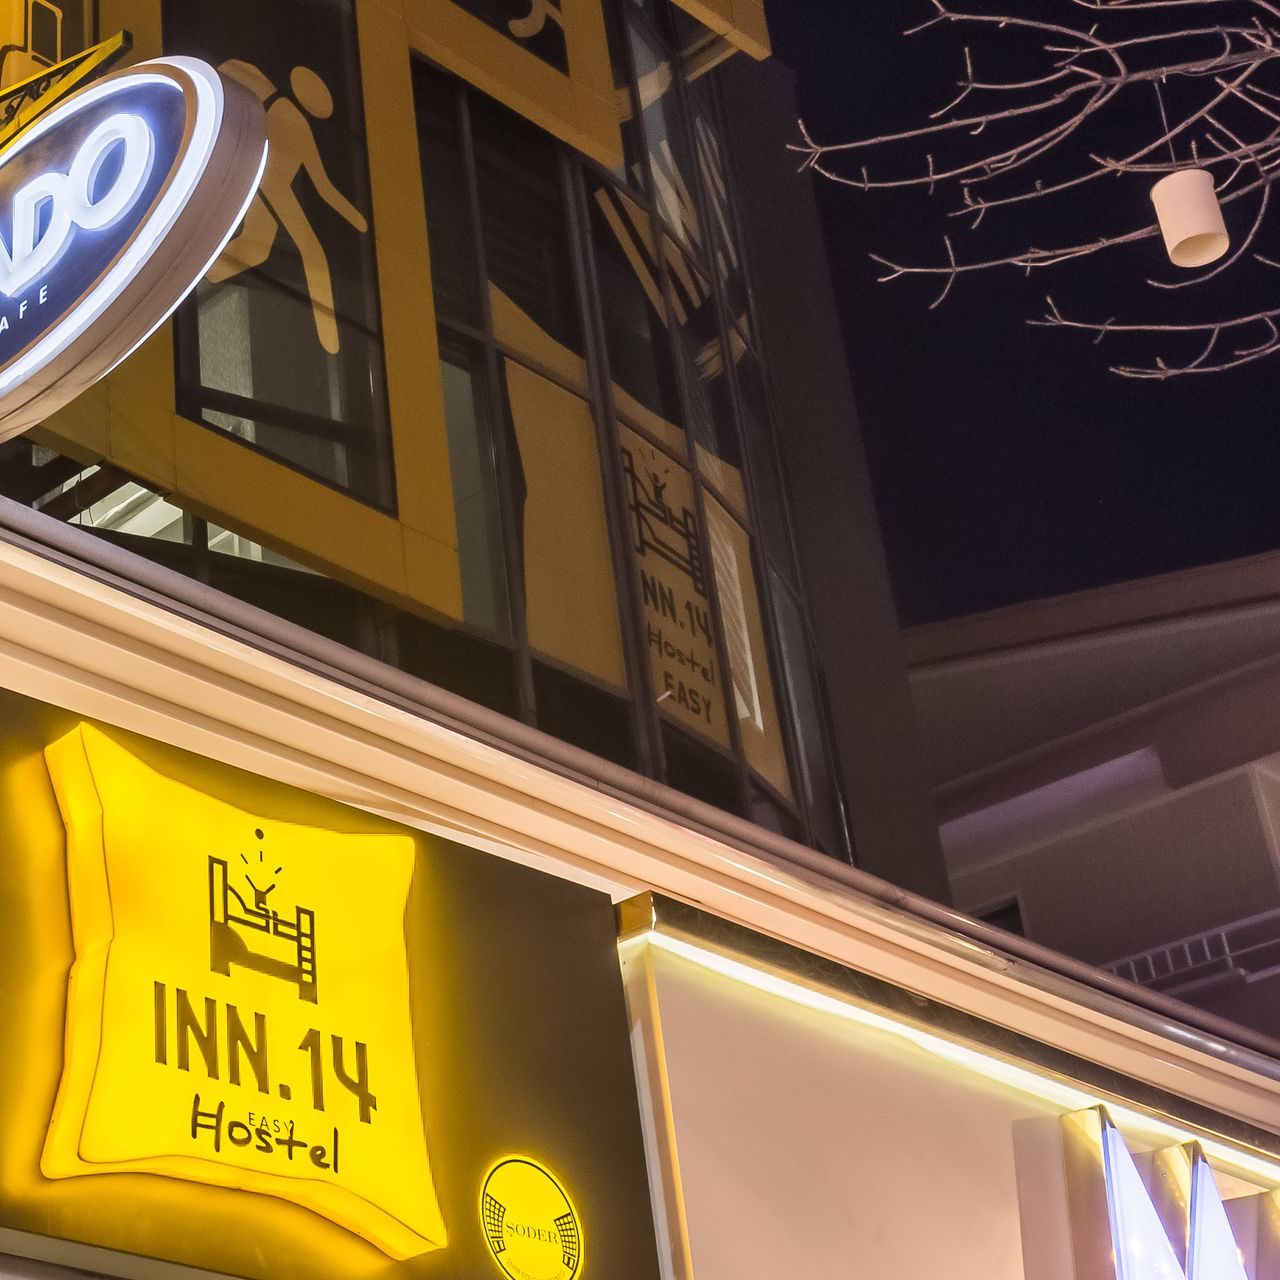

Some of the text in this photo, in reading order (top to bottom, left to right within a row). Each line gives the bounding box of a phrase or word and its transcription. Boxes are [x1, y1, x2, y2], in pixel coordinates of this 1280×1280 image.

[640, 568, 713, 650] NN.14
[648, 620, 715, 687] Hostel
[664, 670, 711, 725] EASY
[154, 980, 378, 1125] INN.14
[191, 1092, 340, 1175] Hostel
[248, 1111, 292, 1135] EASY
